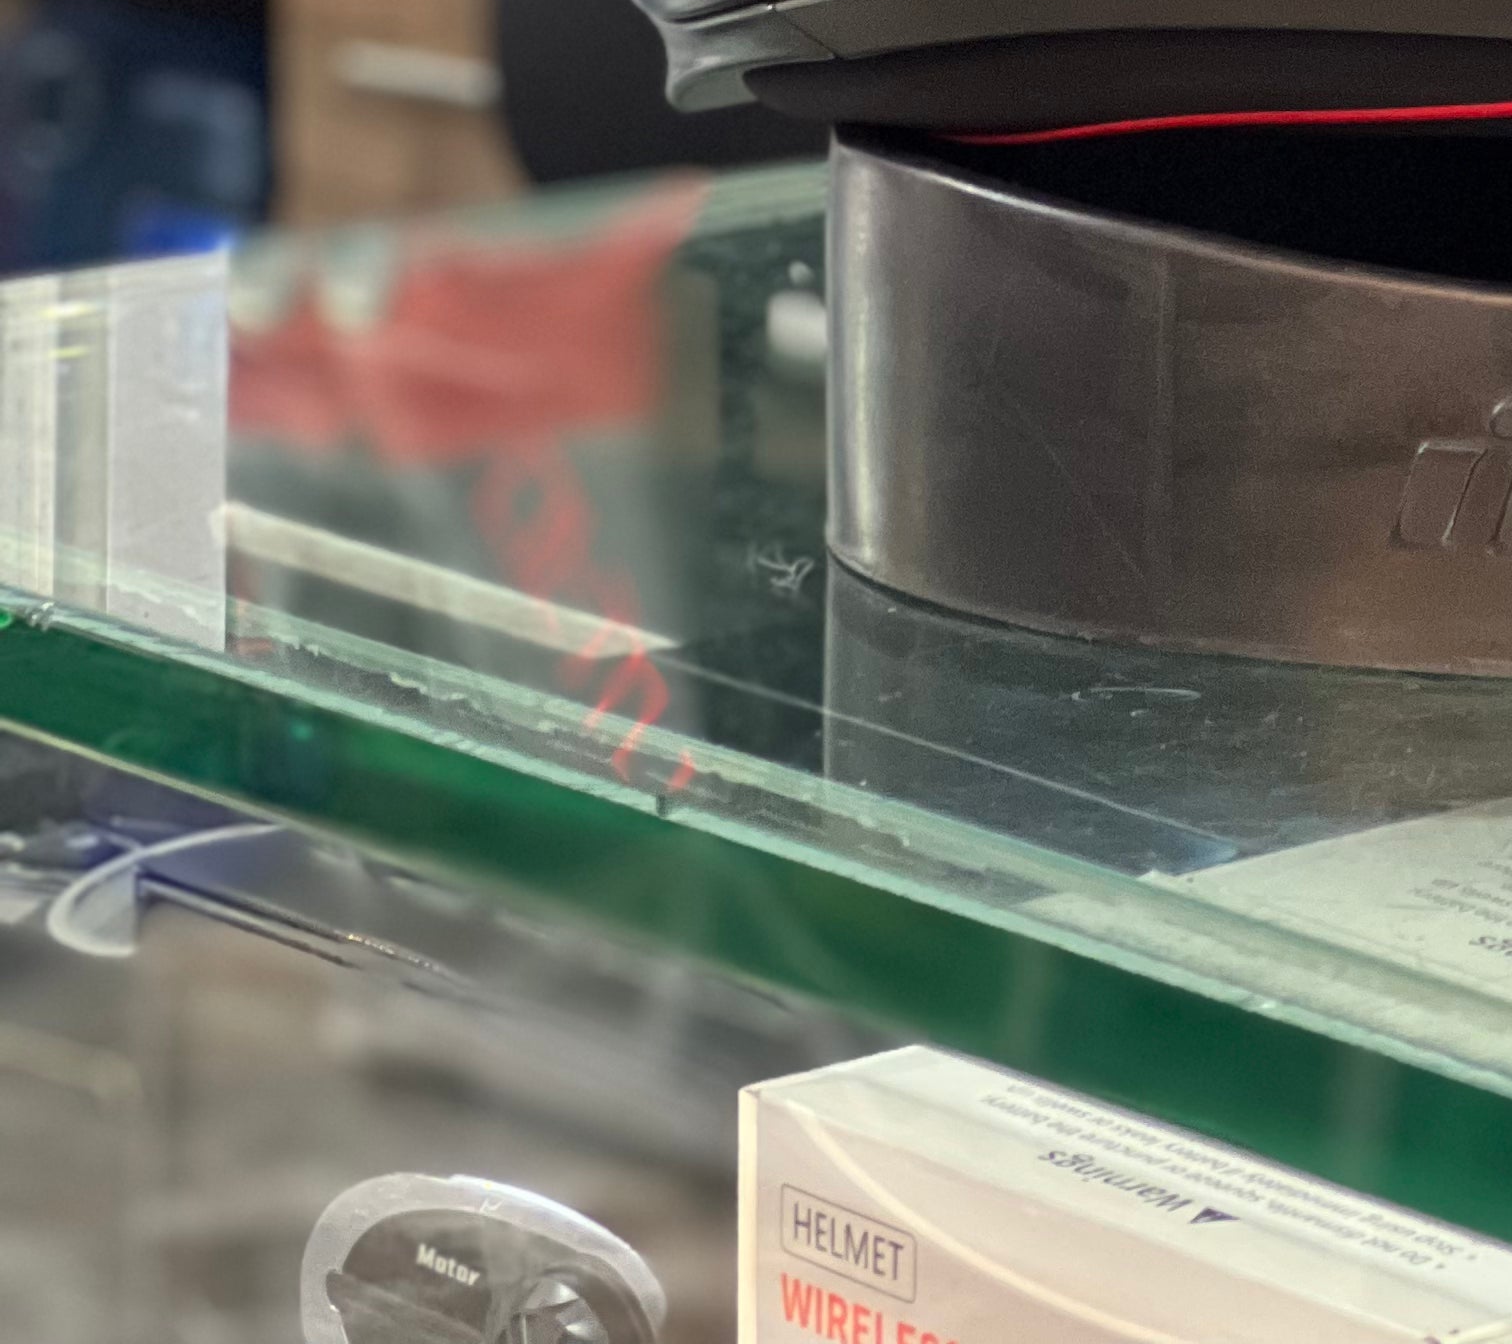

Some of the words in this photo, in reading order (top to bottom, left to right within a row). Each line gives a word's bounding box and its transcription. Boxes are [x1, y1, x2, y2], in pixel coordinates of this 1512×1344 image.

[1038, 1149, 1193, 1212] Warnings
[416, 1243, 481, 1286] Motor
[793, 1201, 905, 1281] HELMET
